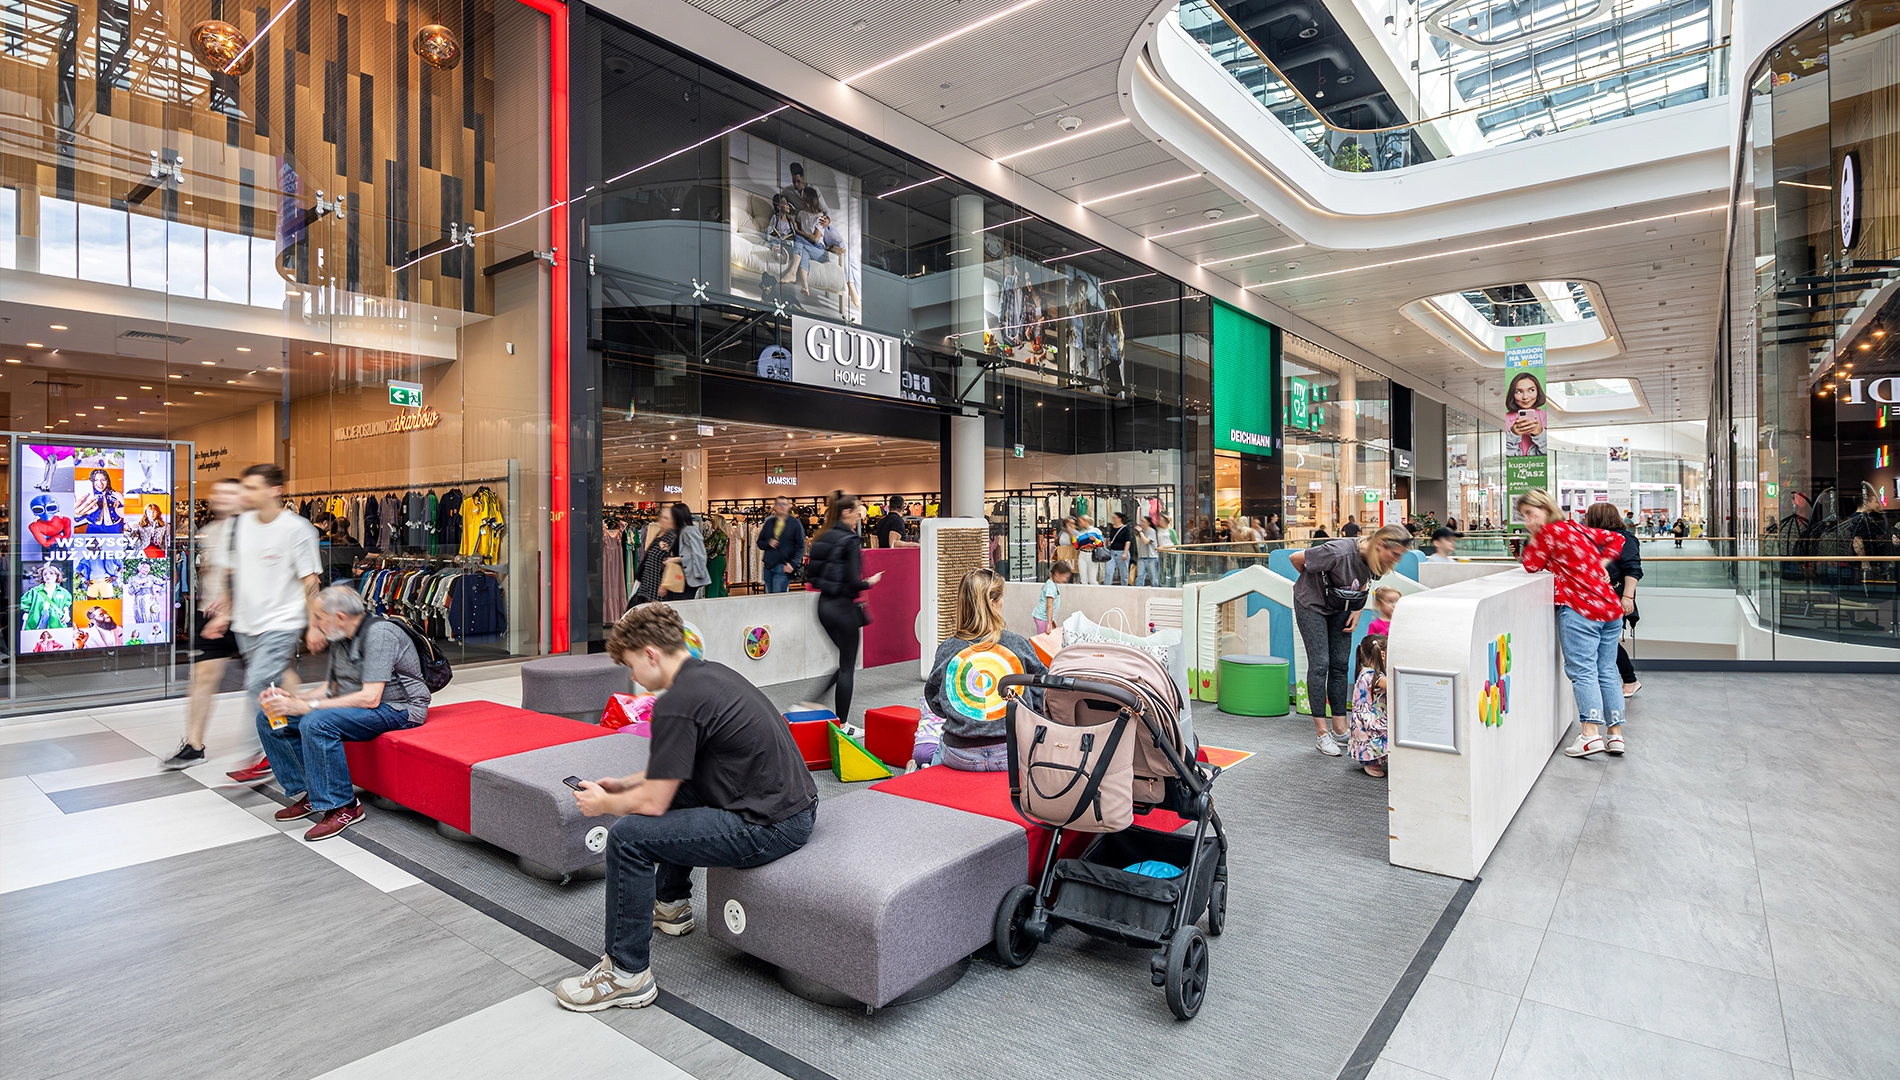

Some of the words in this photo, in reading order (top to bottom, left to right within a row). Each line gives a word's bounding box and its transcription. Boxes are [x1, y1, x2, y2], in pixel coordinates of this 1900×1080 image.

[805, 324, 894, 374] GUDI
[1507, 347, 1543, 355] PARAGON
[834, 369, 867, 387] HOME
[1293, 381, 1306, 401] my
[394, 405, 440, 432] skarbów
[1230, 428, 1271, 448] DEICHMANN
[1508, 461, 1545, 470] kupujesz
[767, 476, 797, 486] DAMSKIE
[54, 537, 139, 548] WSZYSCY
[44, 547, 79, 561] JUŻ
[337, 812, 353, 825] N
[596, 981, 614, 996] N
